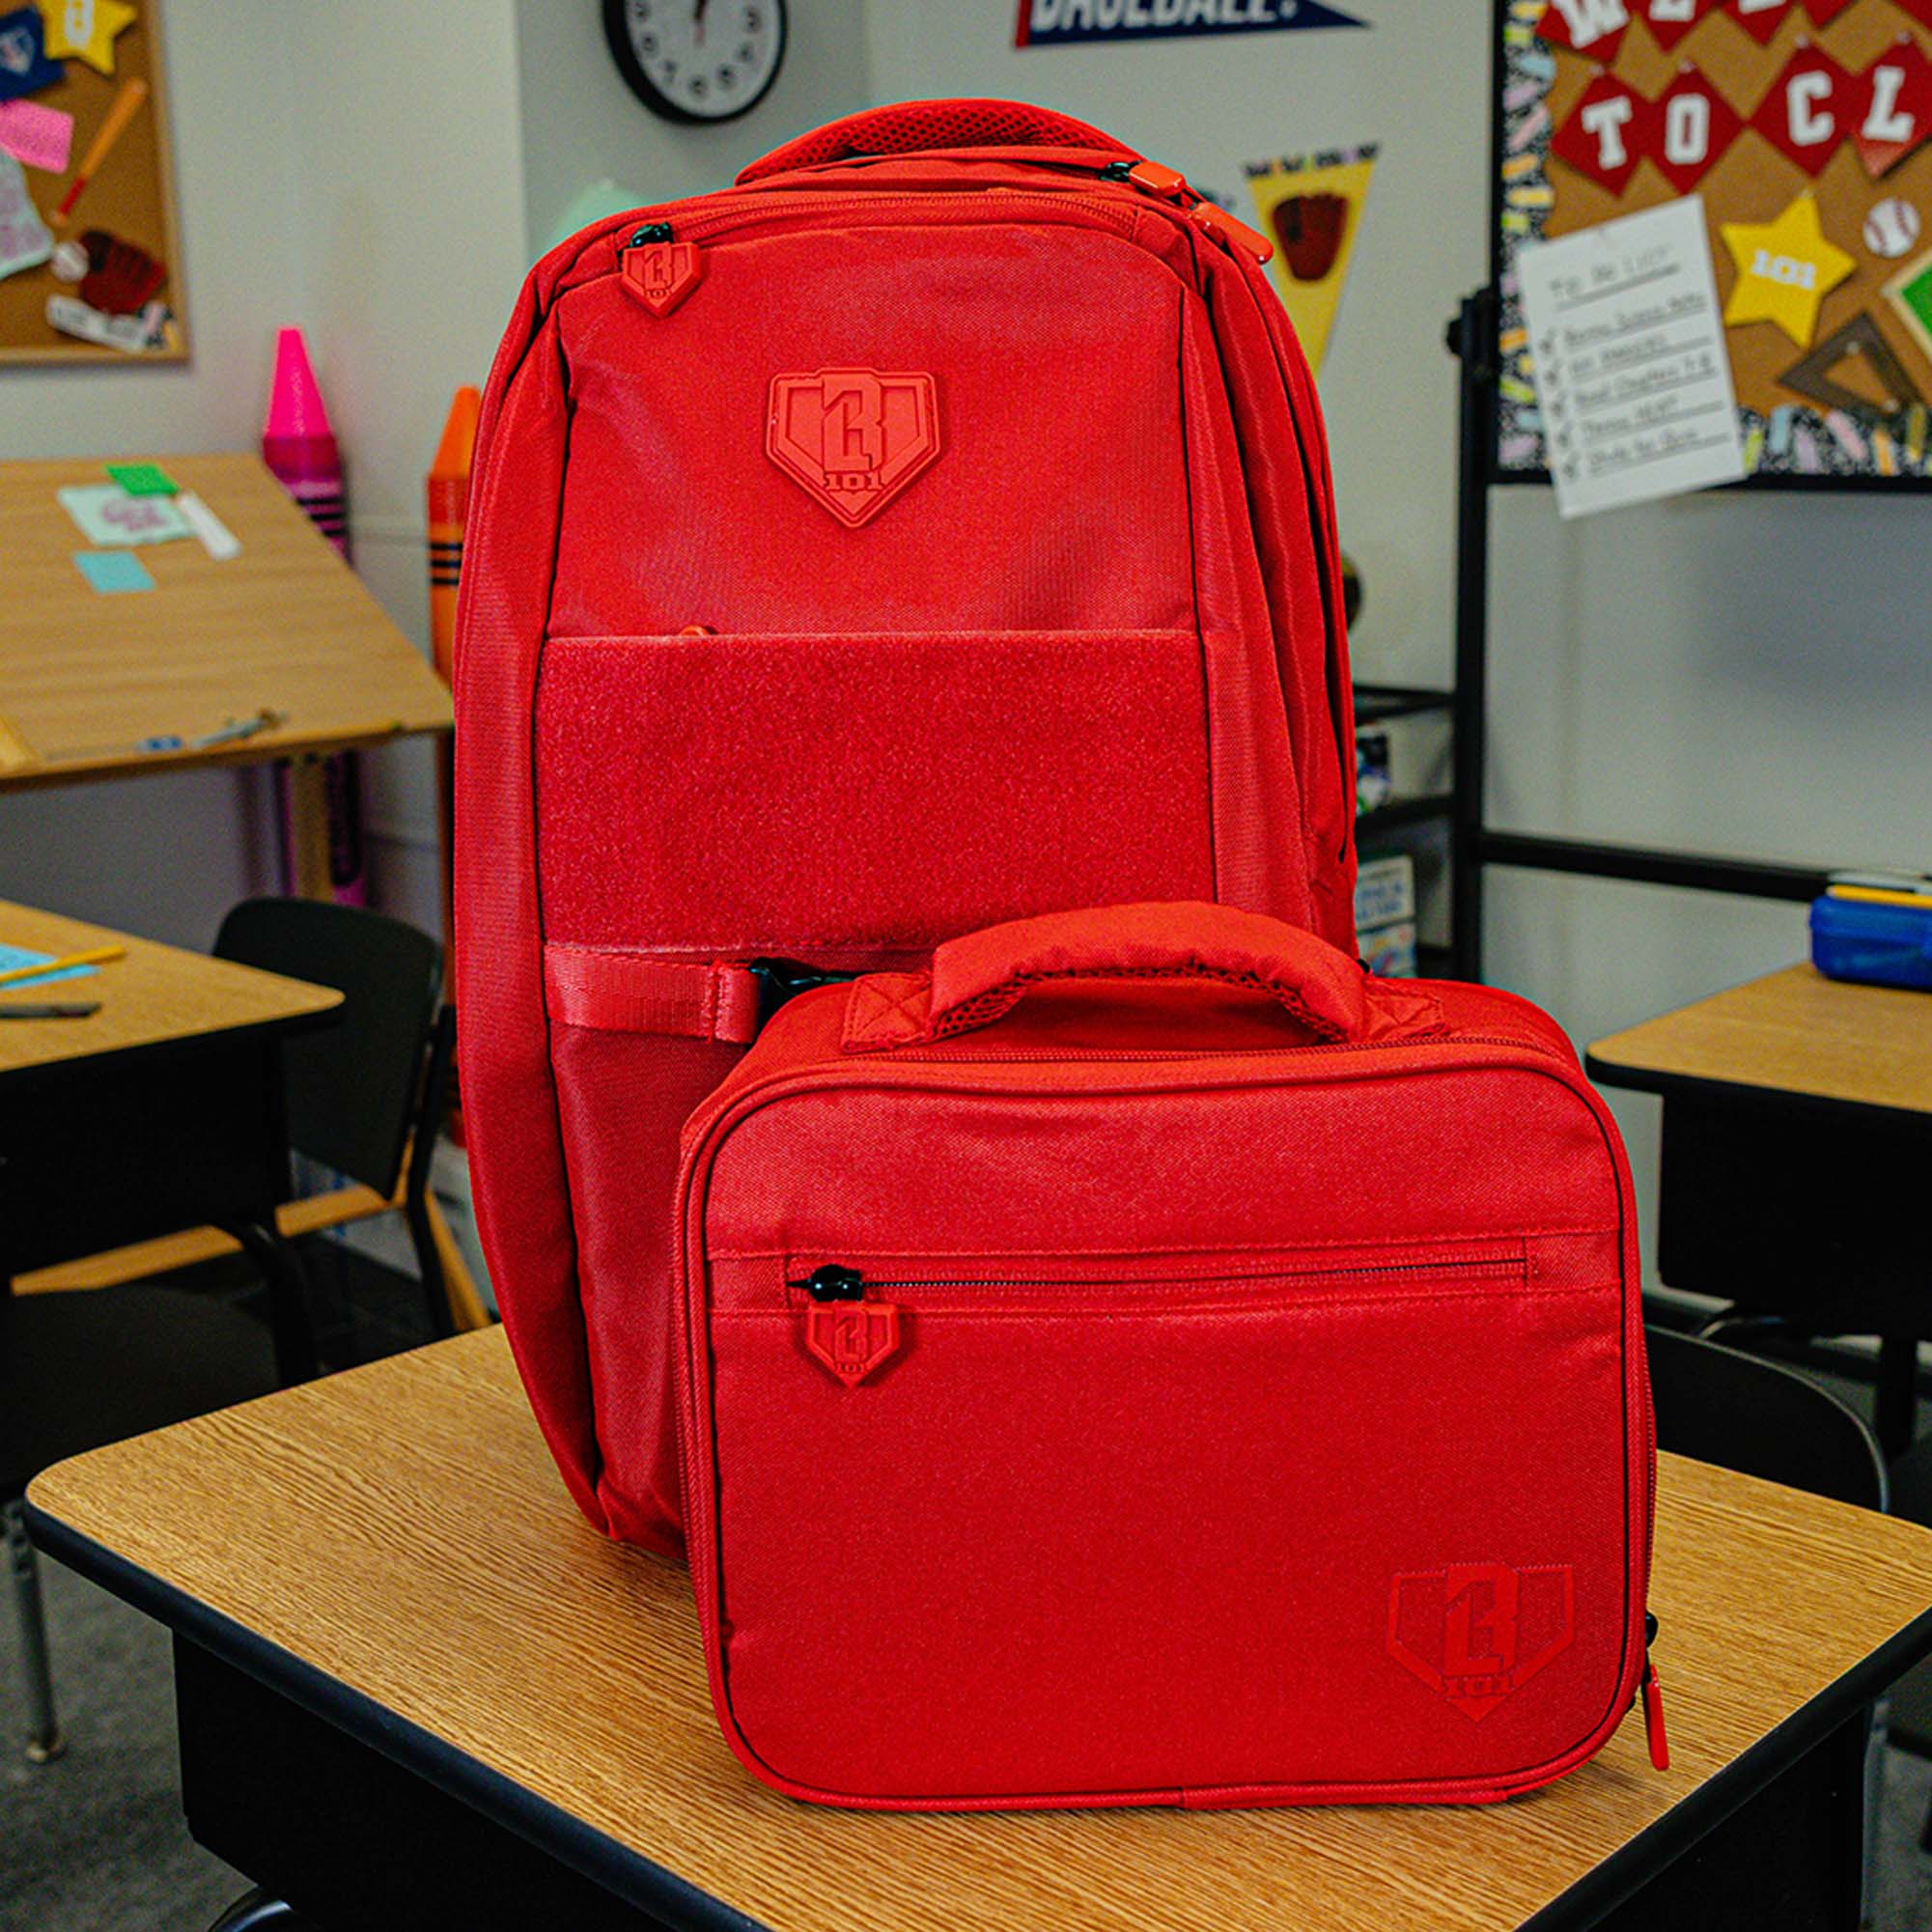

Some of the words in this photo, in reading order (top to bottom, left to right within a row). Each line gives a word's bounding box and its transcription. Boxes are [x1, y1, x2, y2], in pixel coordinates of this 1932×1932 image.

[1582, 93, 1710, 171] TO
[1785, 65, 1915, 147] CL
[1750, 248, 1818, 291] 101
[825, 473, 884, 490] 101
[1444, 1677, 1514, 1696] 101
